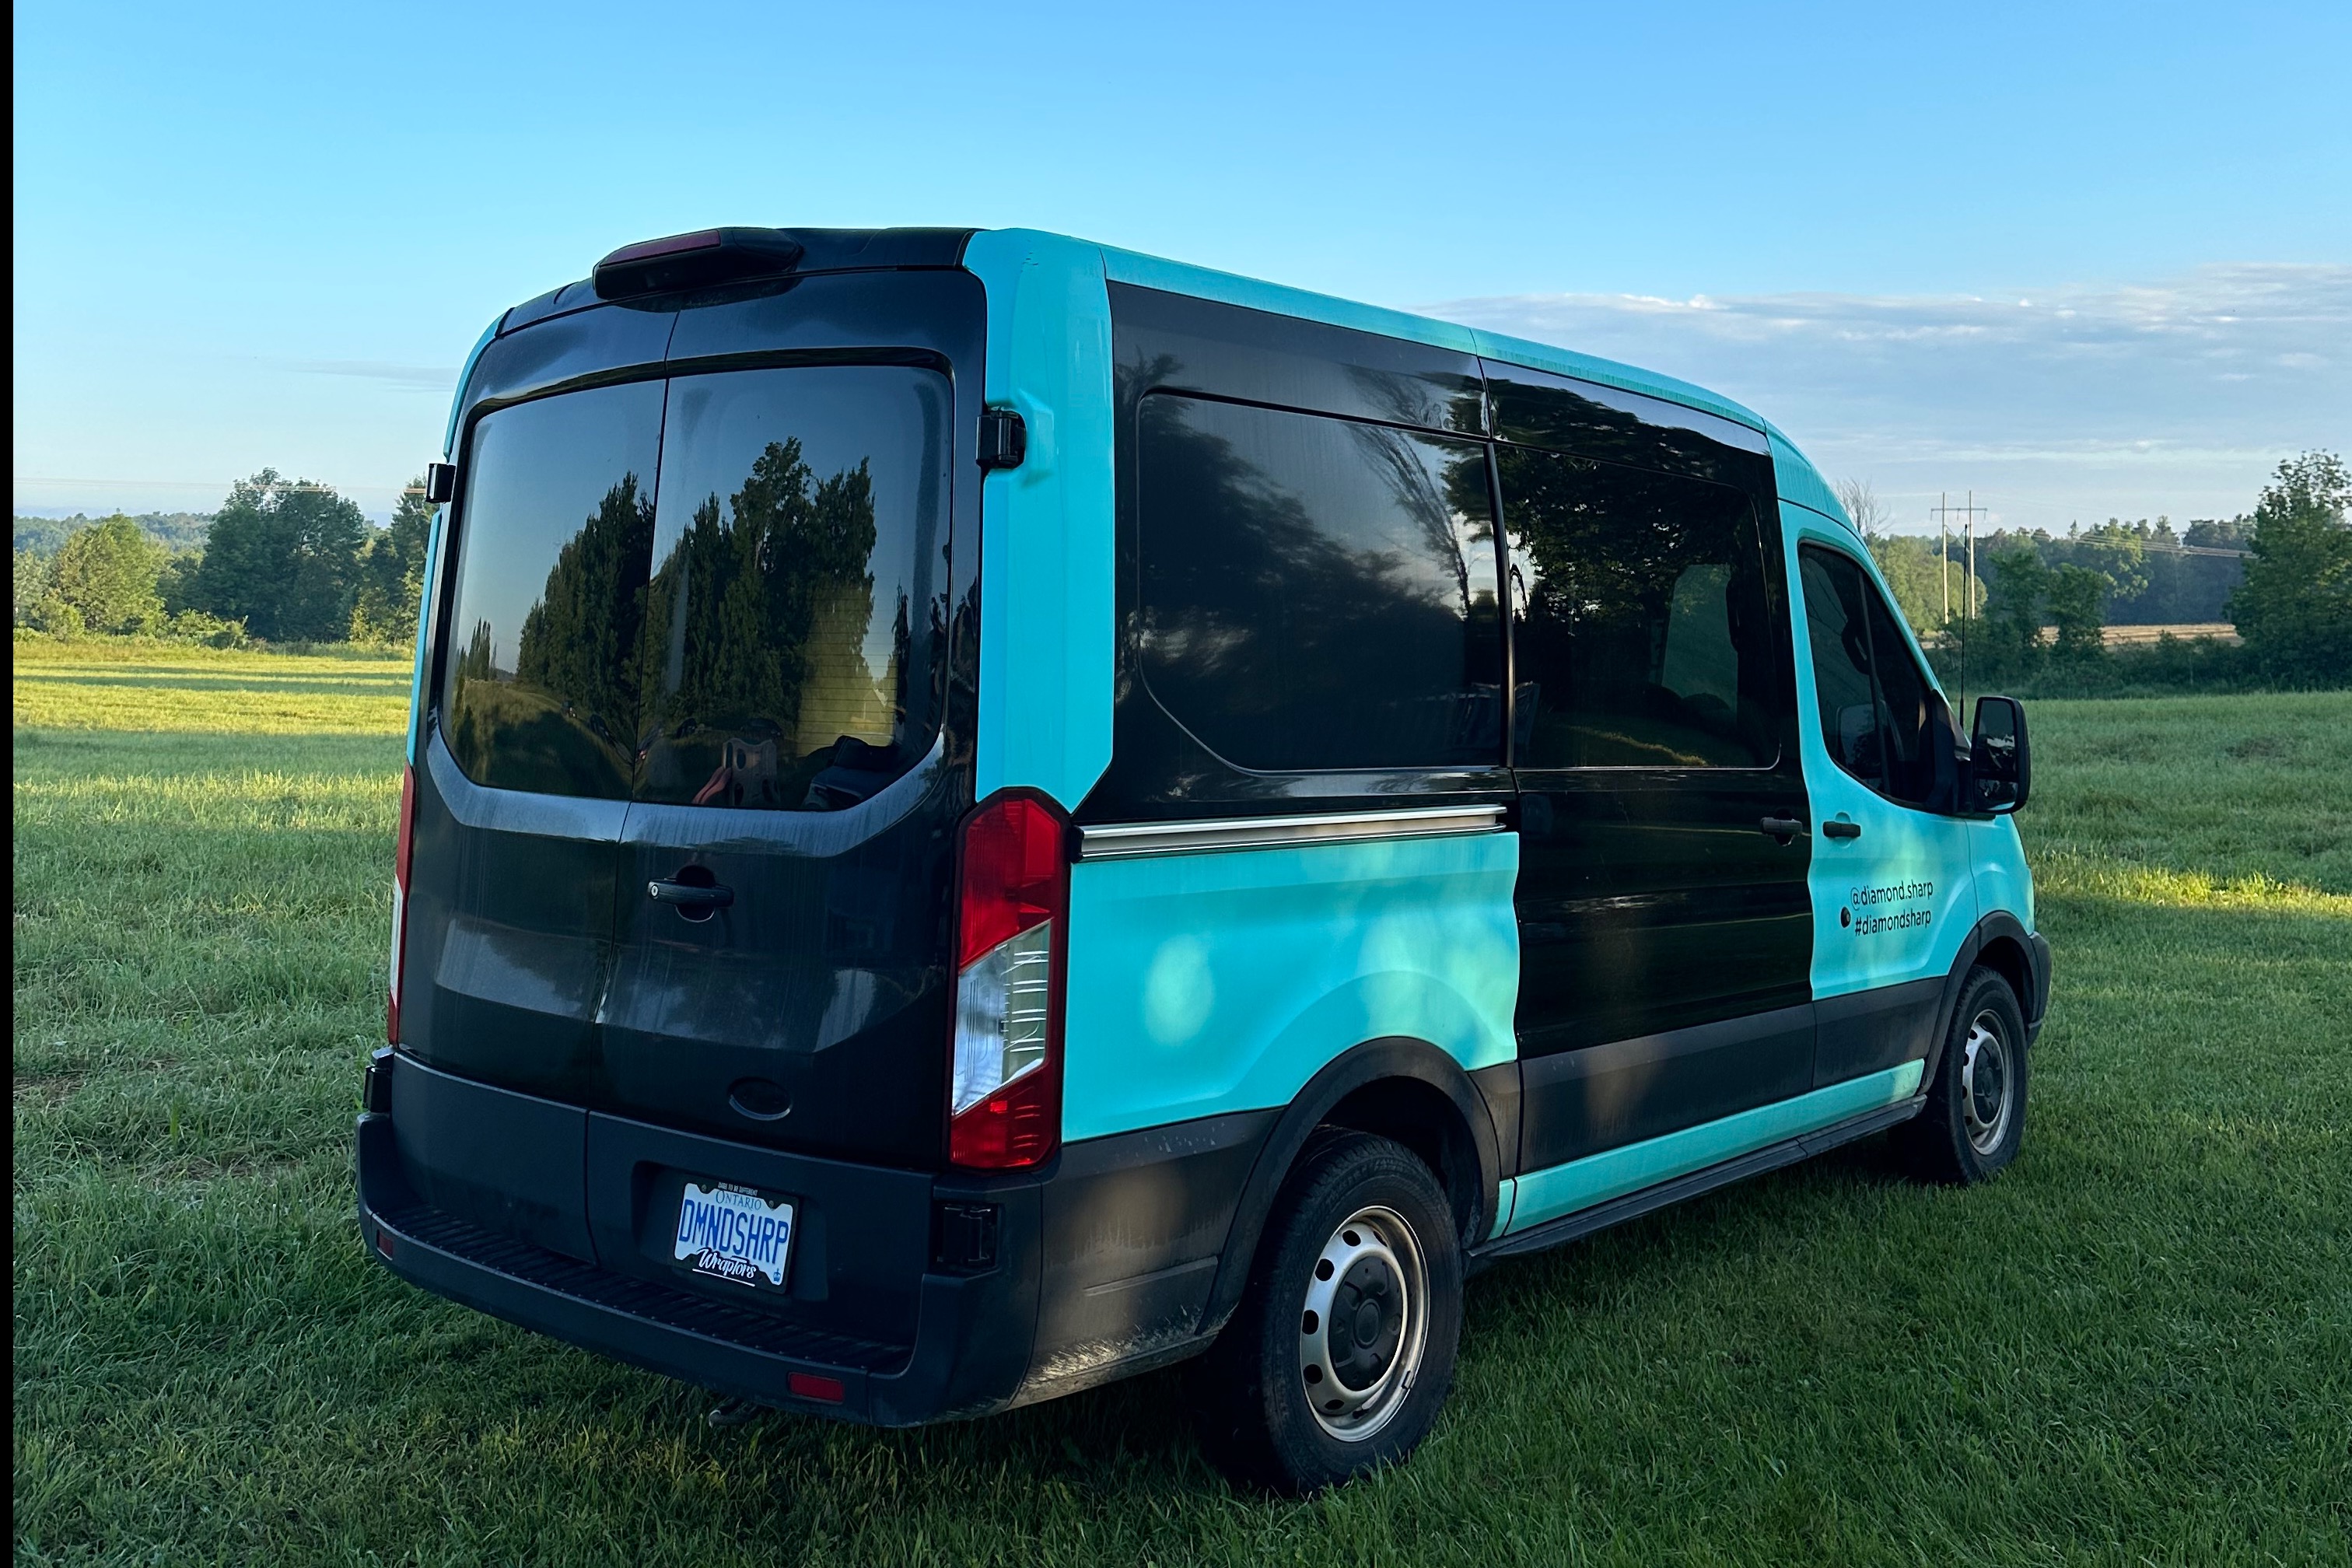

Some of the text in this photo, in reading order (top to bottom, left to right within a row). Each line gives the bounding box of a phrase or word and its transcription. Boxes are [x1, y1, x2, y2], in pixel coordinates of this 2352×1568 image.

[1850, 879, 1934, 911] @diamond.sharp
[1854, 908, 1931, 936] #diamondsharp
[678, 1199, 789, 1265] DMNDSHRP
